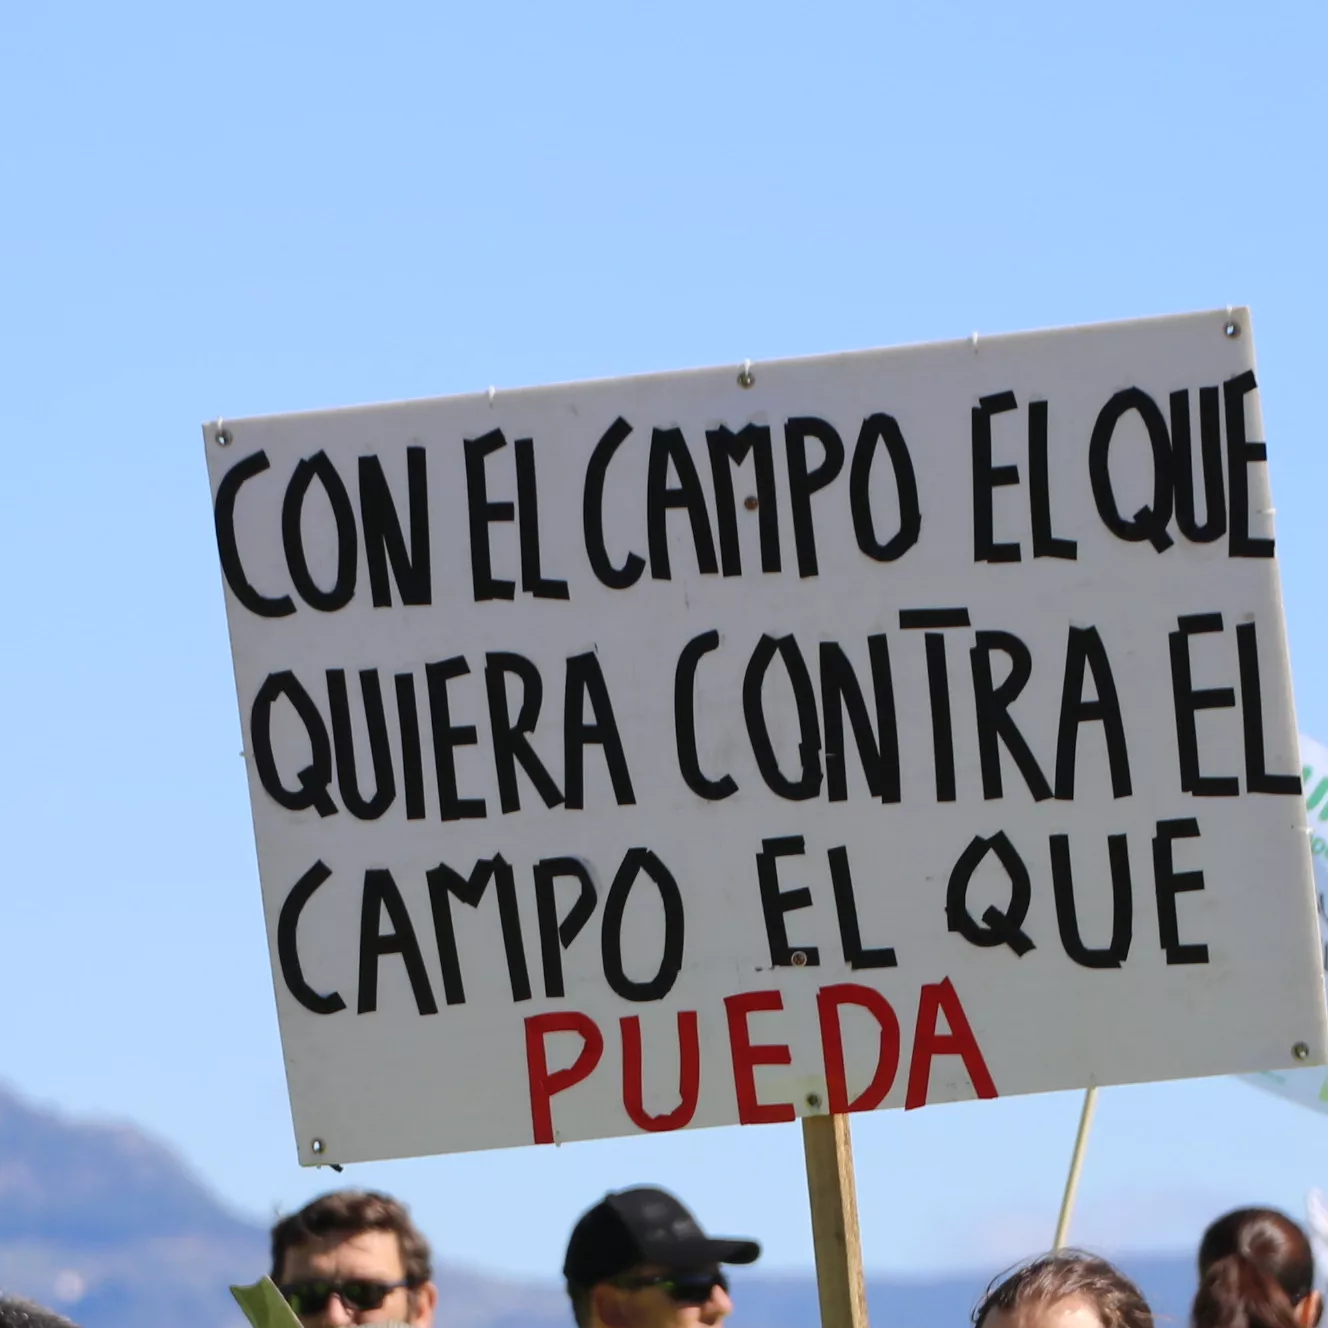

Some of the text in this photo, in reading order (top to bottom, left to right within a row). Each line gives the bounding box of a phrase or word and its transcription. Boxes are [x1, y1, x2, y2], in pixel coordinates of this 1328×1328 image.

[215, 370, 1275, 618] CON EL CAMPO EL QUE
[250, 607, 1303, 821] QUIERA CONTRA EL
[277, 817, 1210, 1016] CAMPO EL QUE
[524, 976, 999, 1145] PUEDA
